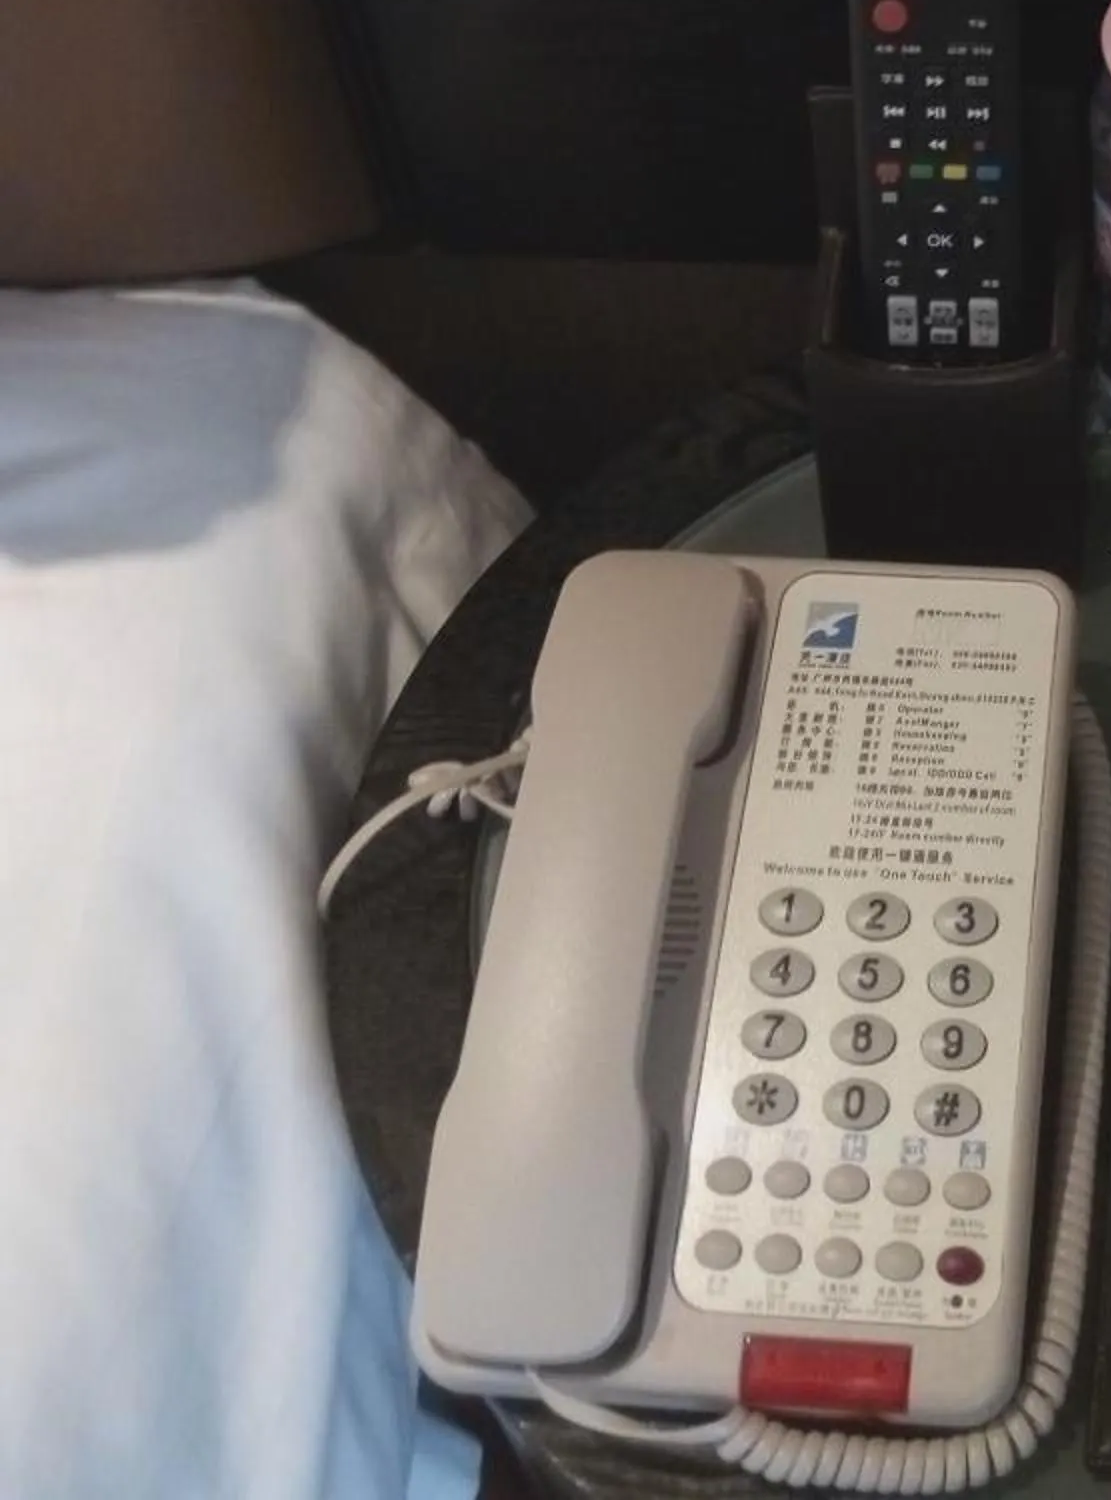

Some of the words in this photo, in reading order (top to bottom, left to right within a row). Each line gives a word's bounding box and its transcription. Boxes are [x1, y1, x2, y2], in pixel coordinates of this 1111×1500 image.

[927, 233, 953, 249] OK
[763, 861, 824, 877] Welcome
[781, 893, 796, 924] 1
[864, 899, 888, 931] 2
[954, 901, 976, 934] 3
[769, 953, 792, 986] 4
[857, 958, 880, 991] 5
[949, 963, 971, 996] 6
[762, 1013, 785, 1048] 7
[851, 1020, 872, 1053] 8
[942, 1025, 964, 1059] 9
[842, 1085, 865, 1120] 0
